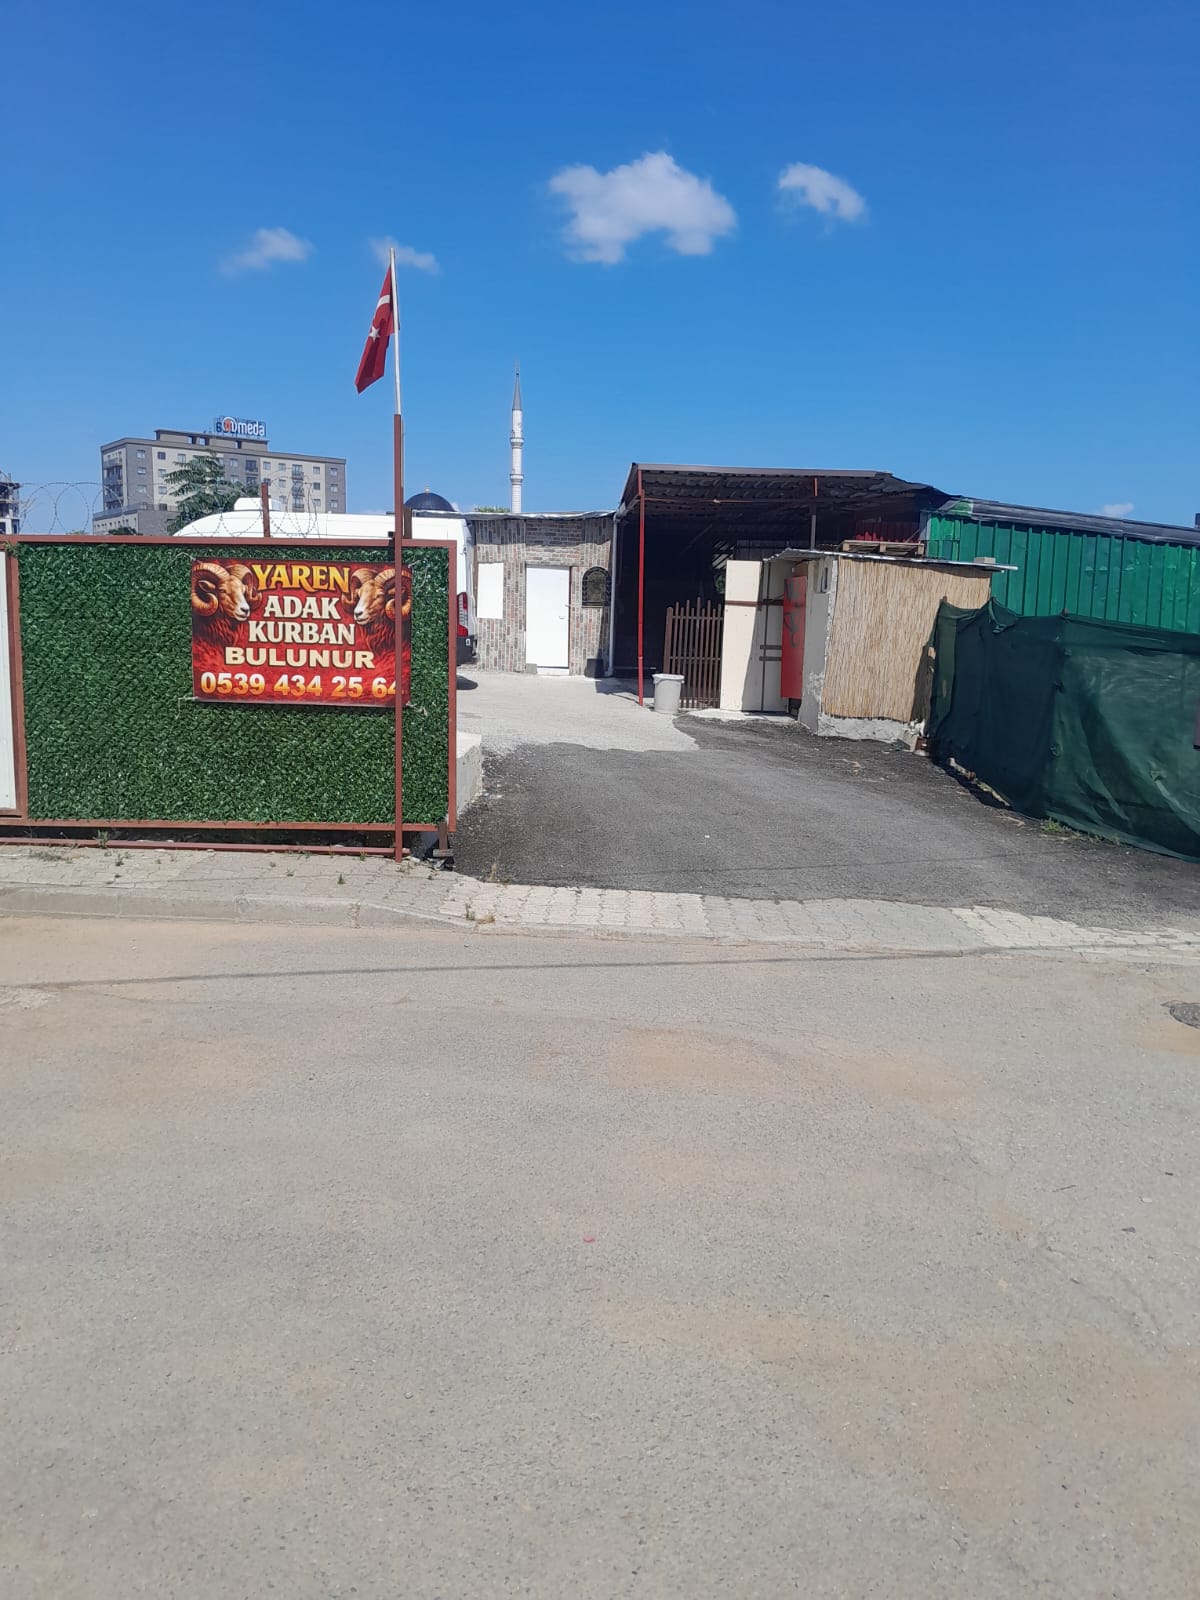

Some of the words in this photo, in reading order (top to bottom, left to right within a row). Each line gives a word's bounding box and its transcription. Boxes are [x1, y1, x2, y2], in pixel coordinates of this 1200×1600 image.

[252, 564, 350, 594] YAREN
[263, 595, 341, 620] ADAK
[248, 621, 356, 645] KURBAN
[225, 647, 375, 669] BULUNUR
[201, 671, 265, 695] 0539
[274, 673, 323, 697] 434
[331, 675, 363, 698] 25
